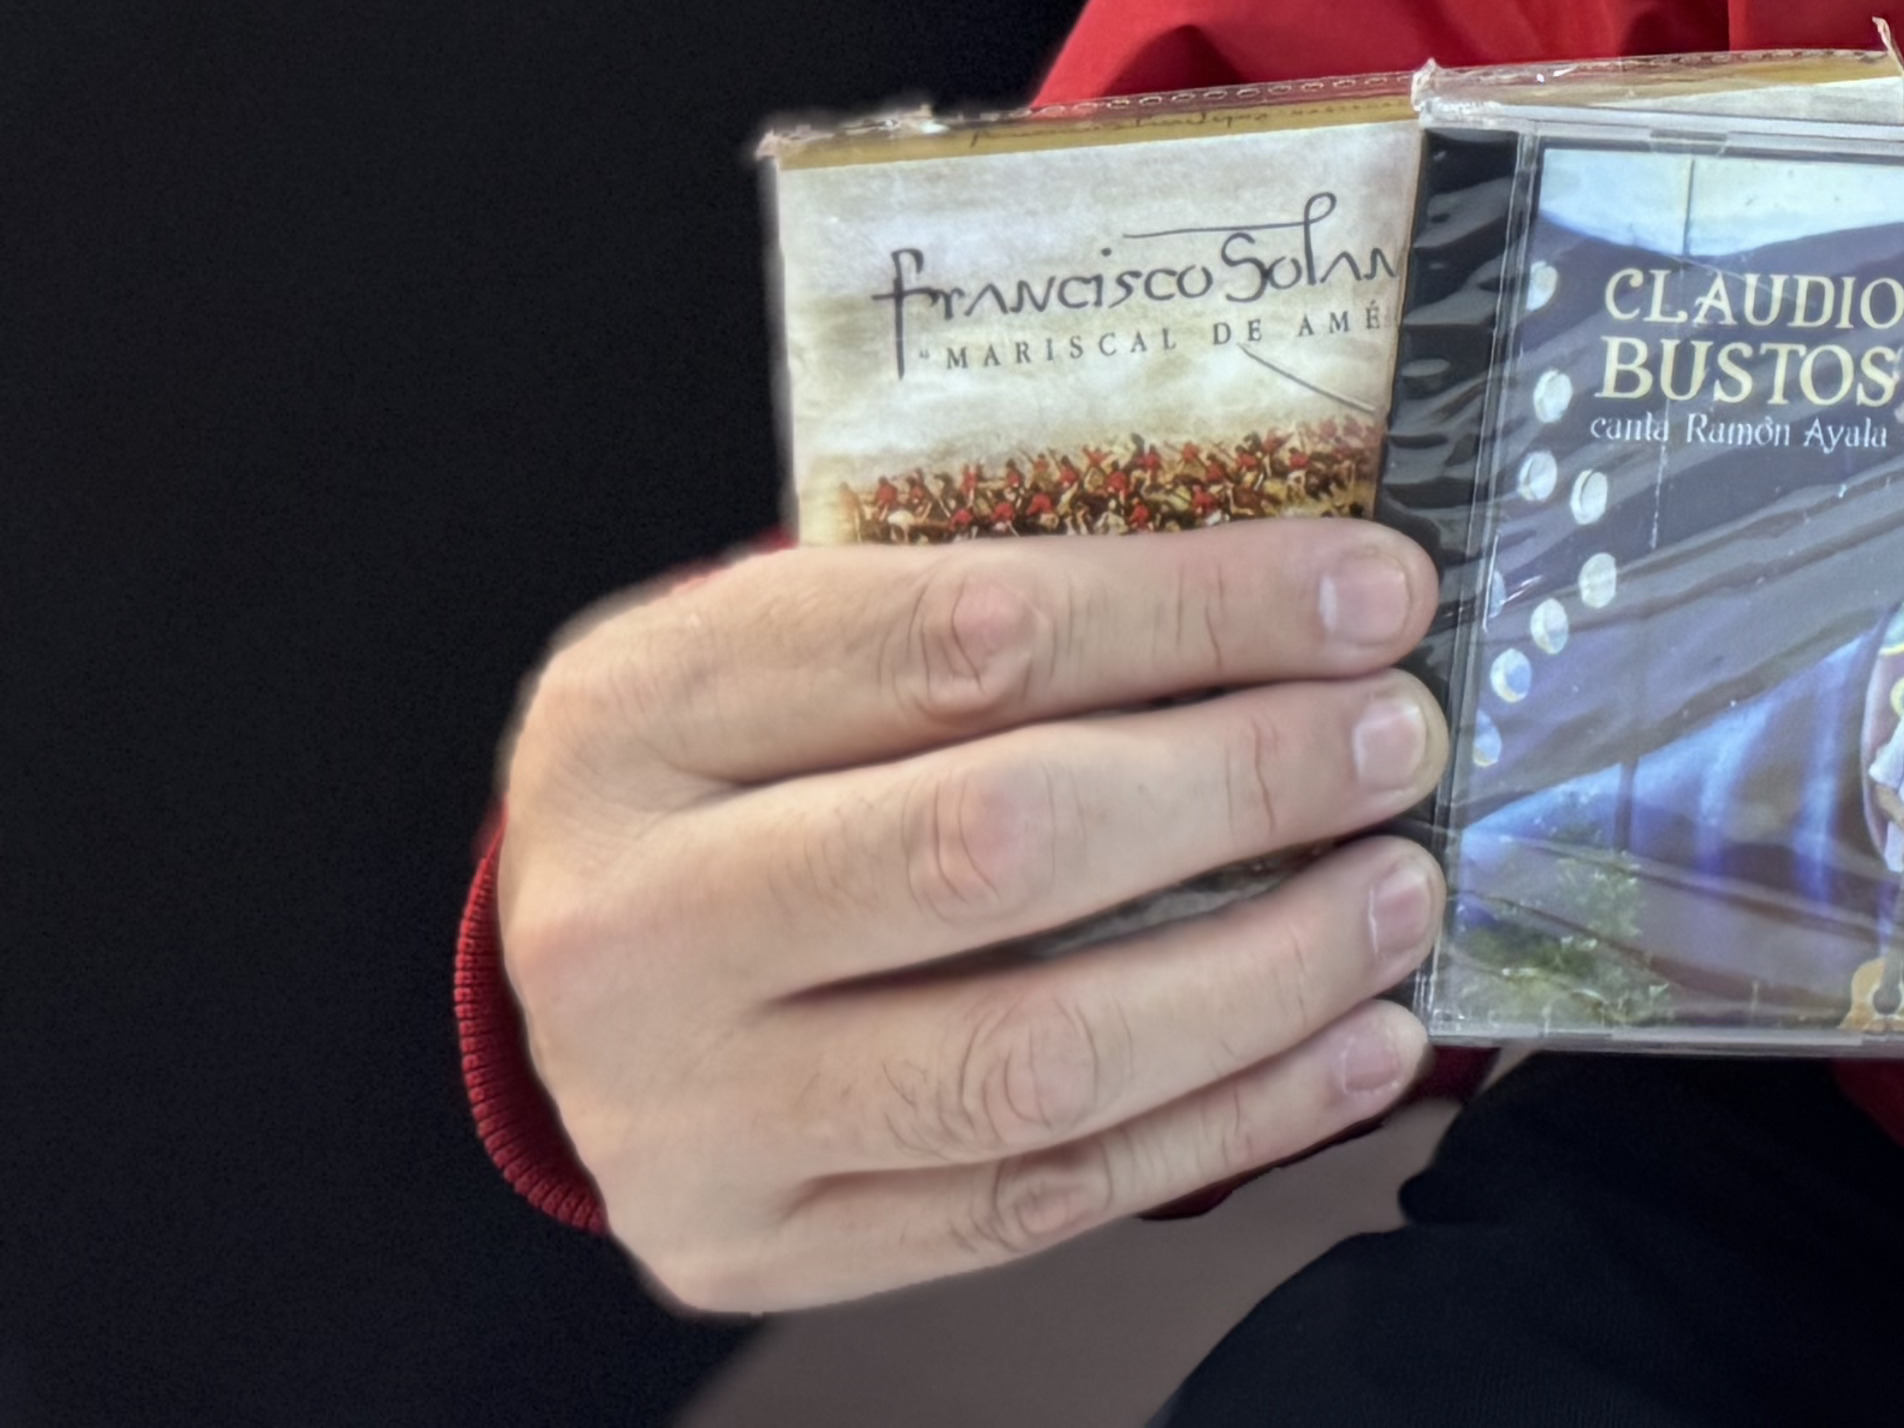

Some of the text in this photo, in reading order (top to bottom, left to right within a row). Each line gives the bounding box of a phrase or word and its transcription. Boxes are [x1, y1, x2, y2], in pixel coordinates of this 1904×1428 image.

[1212, 318, 1263, 347] DE
[1297, 298, 1391, 339] AMÉ
[1593, 334, 1900, 408] BUSTOS
[1589, 411, 1888, 454] canta Ramón Ayala
